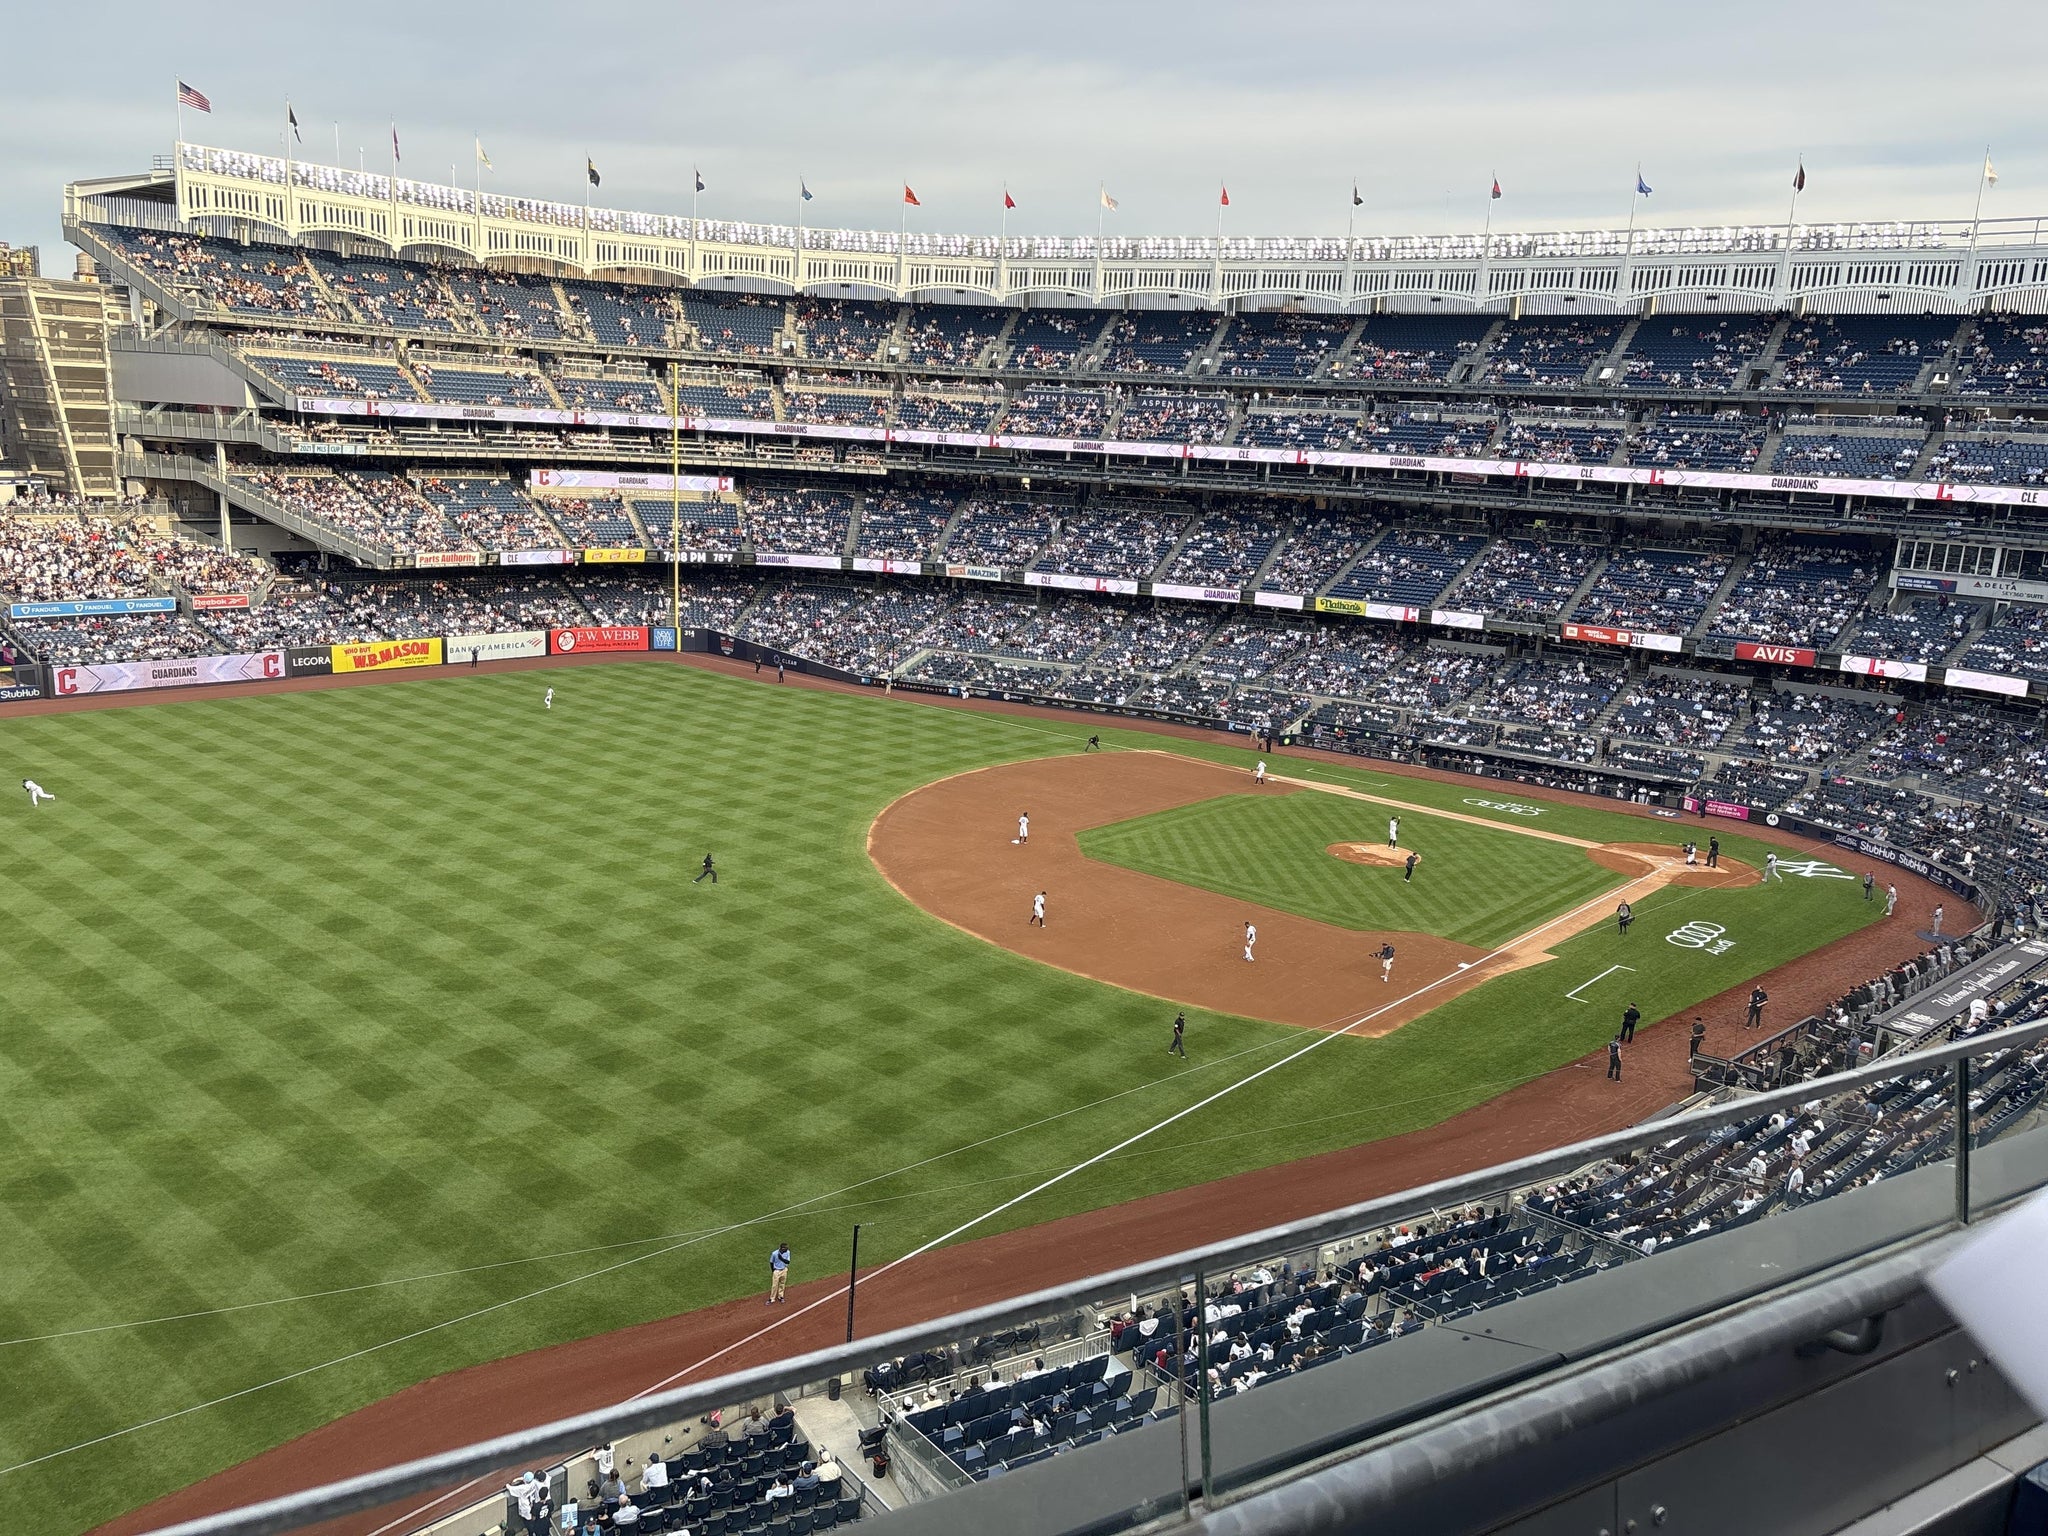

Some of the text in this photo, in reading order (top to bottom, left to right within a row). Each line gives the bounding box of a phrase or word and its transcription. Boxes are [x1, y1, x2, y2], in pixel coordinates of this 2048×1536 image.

[1027, 394, 1100, 405] ASPEN VODKA
[1141, 400, 1174, 408] ASPEN
[302, 401, 315, 411] CLE
[462, 408, 496, 419] GUARDIANS
[628, 416, 639, 426] CLE
[774, 424, 808, 434] GUARDIANS
[937, 434, 947, 443] CLE
[1072, 441, 1104, 451] GUARDIANS
[1238, 450, 1250, 459] CLE
[1389, 457, 1426, 468] GUARDIANS
[1580, 468, 1593, 479] CLE
[618, 477, 648, 485] GUARDIANS
[1771, 477, 1819, 490] GUARDIANS
[2021, 492, 2038, 503] CLE
[419, 553, 477, 564] Parts Authority
[507, 554, 518, 563] CLE
[690, 552, 706, 563] PM
[755, 555, 790, 564] GUARDIANS
[967, 568, 999, 578] AMAZING
[1040, 575, 1052, 584] CLE
[1984, 581, 2017, 591] DELTA
[1203, 589, 1240, 600] GUARDIANS
[194, 598, 227, 606] Reebok
[1320, 598, 1361, 612] Nathan's
[577, 630, 639, 641] F.W. WEBB
[1631, 632, 1645, 645] CLE
[449, 646, 474, 654] BANK
[487, 642, 525, 651] AMERICA
[1753, 647, 1796, 663] AVIS
[292, 655, 332, 667] LEGORA
[151, 666, 198, 680] GUARDIANS
[0, 688, 41, 699] StubHub
[1860, 841, 1896, 860] StubHub
[1898, 853, 1928, 874] StubHub
[1704, 938, 1737, 956] Audi
[1931, 989, 1971, 1008] Welcome
[1985, 959, 2022, 979] Stadium
